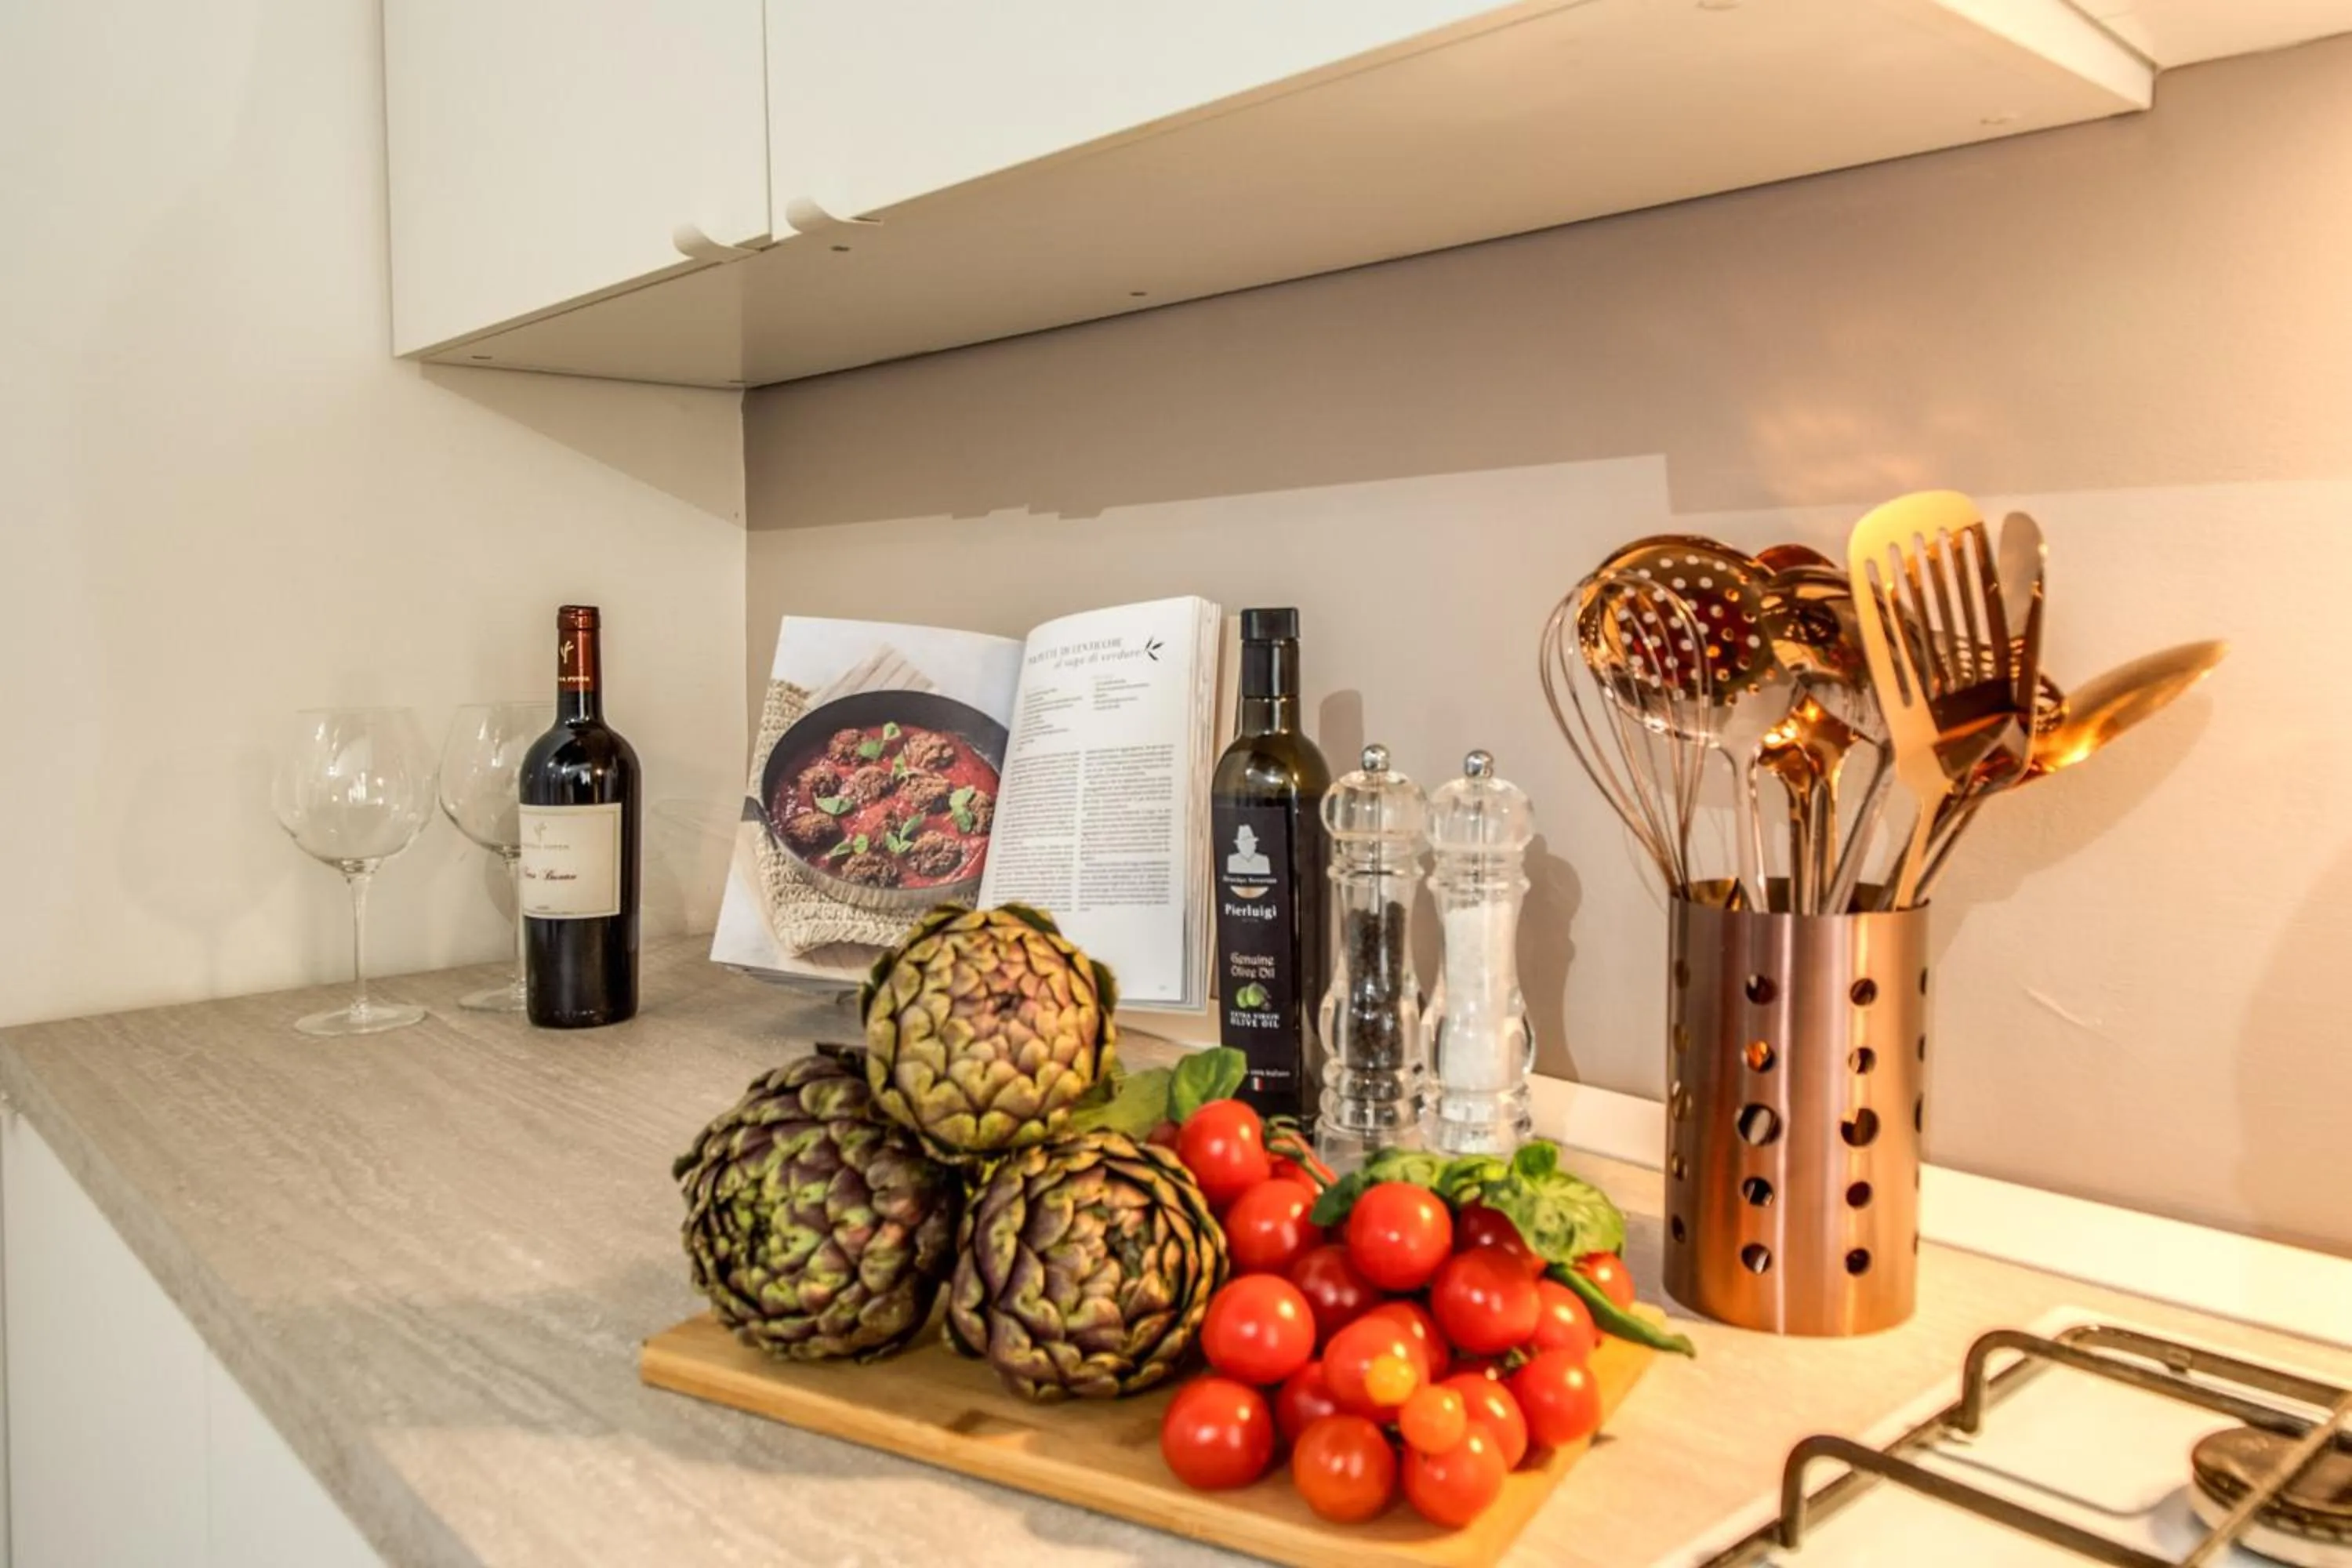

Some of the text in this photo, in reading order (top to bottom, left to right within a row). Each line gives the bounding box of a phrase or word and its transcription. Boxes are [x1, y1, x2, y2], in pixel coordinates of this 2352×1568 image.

[1225, 903, 1277, 920] Pierluigi
[1230, 952, 1274, 967] Genuine
[1230, 965, 1276, 979] Olive Oil
[1230, 1018, 1279, 1029] OLIVE OIL
